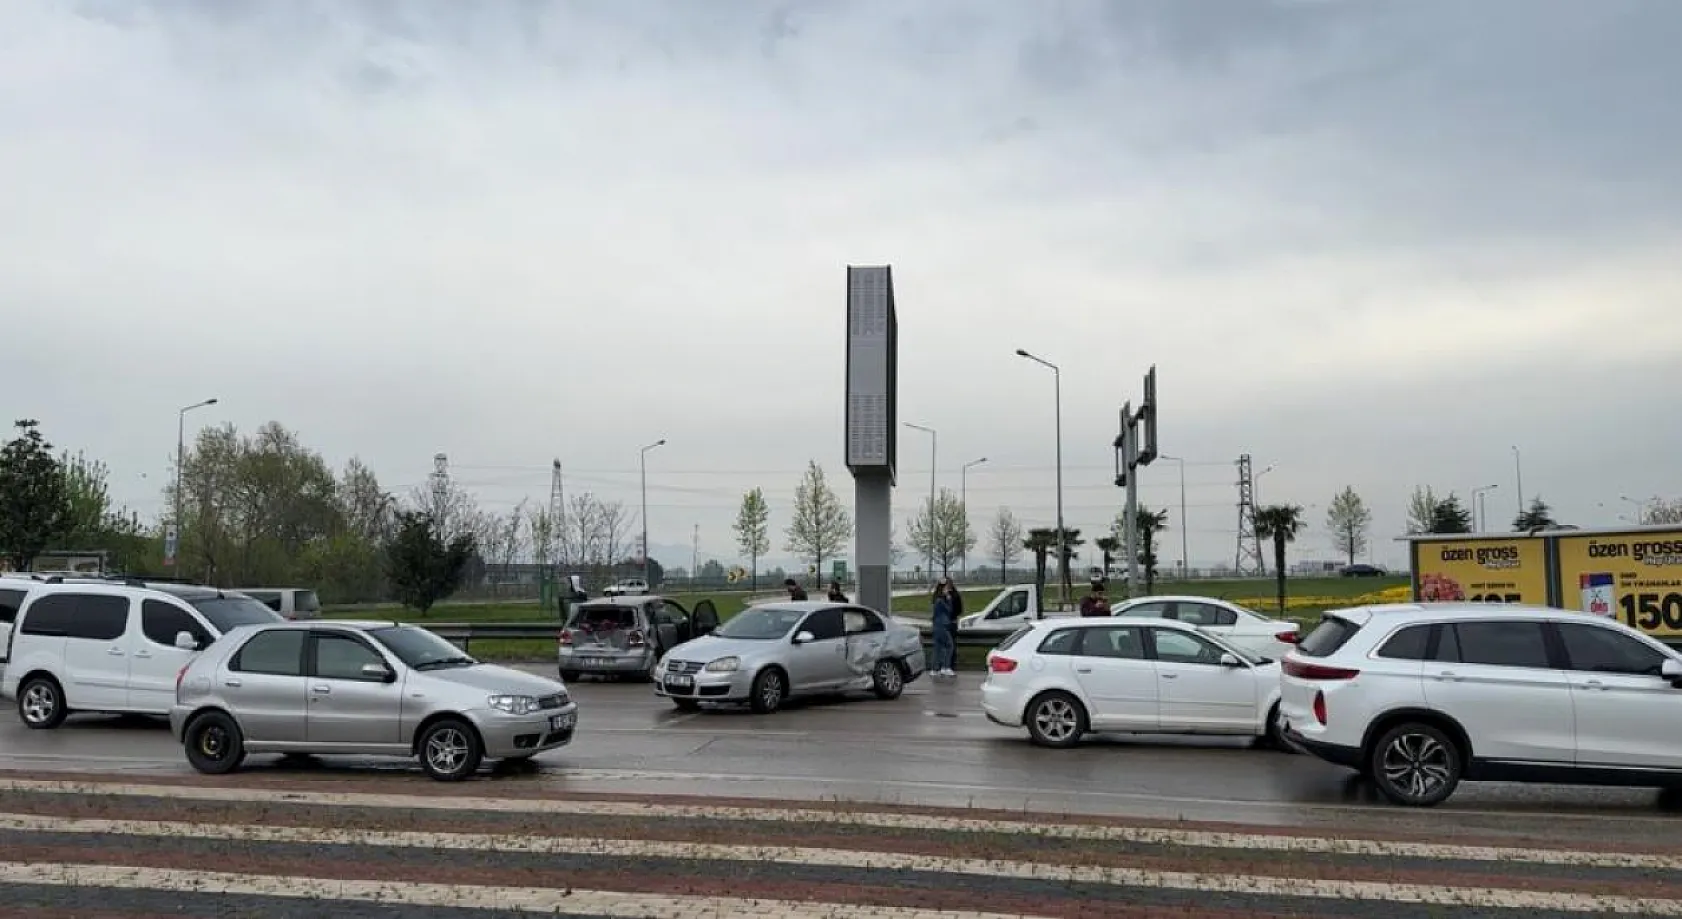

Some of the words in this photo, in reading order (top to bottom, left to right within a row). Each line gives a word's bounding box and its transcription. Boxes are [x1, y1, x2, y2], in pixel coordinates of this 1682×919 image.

[1441, 545, 1473, 560] özen
[1476, 546, 1518, 564] gross
[1588, 540, 1629, 557] özen
[1619, 592, 1682, 630] 150
